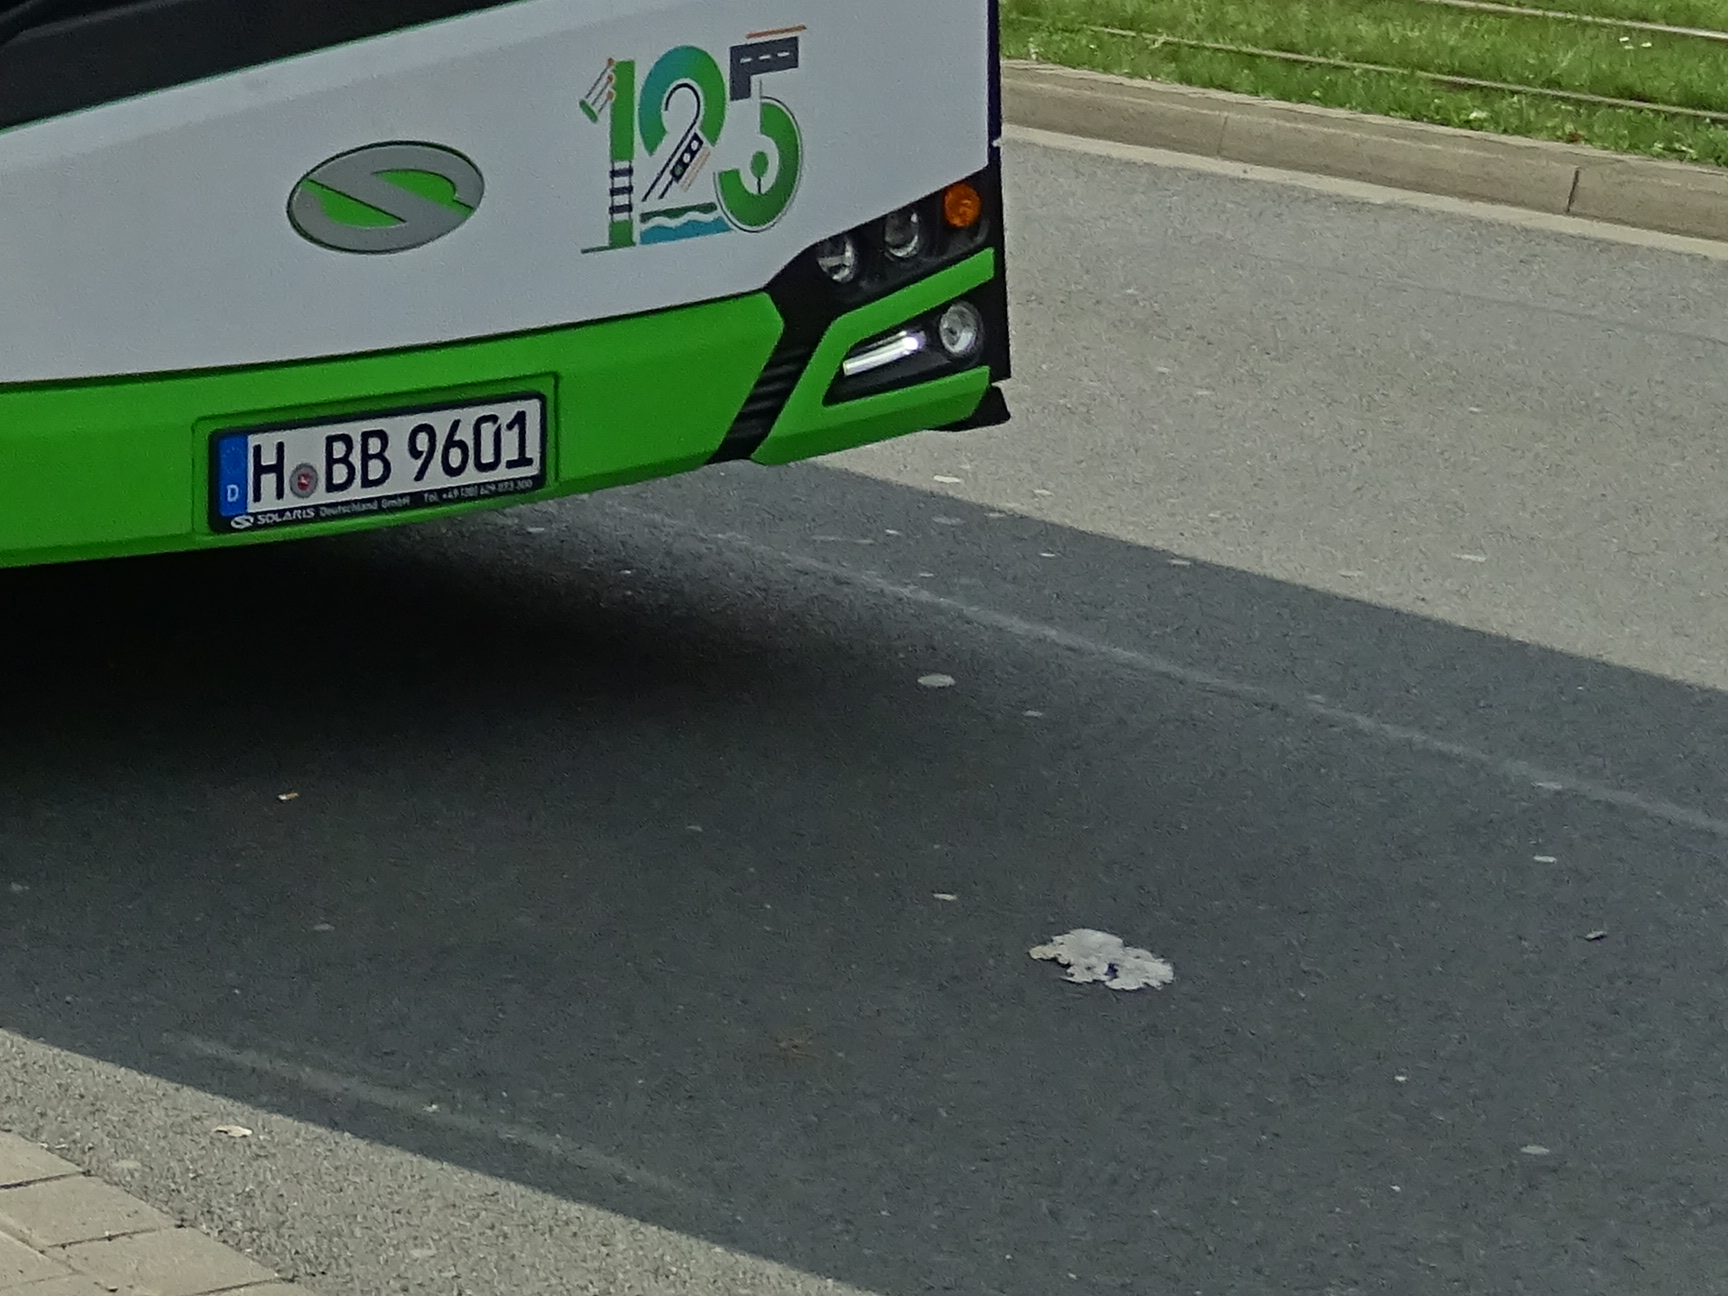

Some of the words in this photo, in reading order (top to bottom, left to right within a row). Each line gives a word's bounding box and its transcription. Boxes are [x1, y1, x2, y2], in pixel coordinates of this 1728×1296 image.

[577, 25, 808, 256] 125
[252, 440, 286, 504] H
[324, 428, 392, 494] BB
[407, 409, 535, 483] 9601
[226, 483, 240, 503] D
[256, 506, 315, 526] SOLARIS
